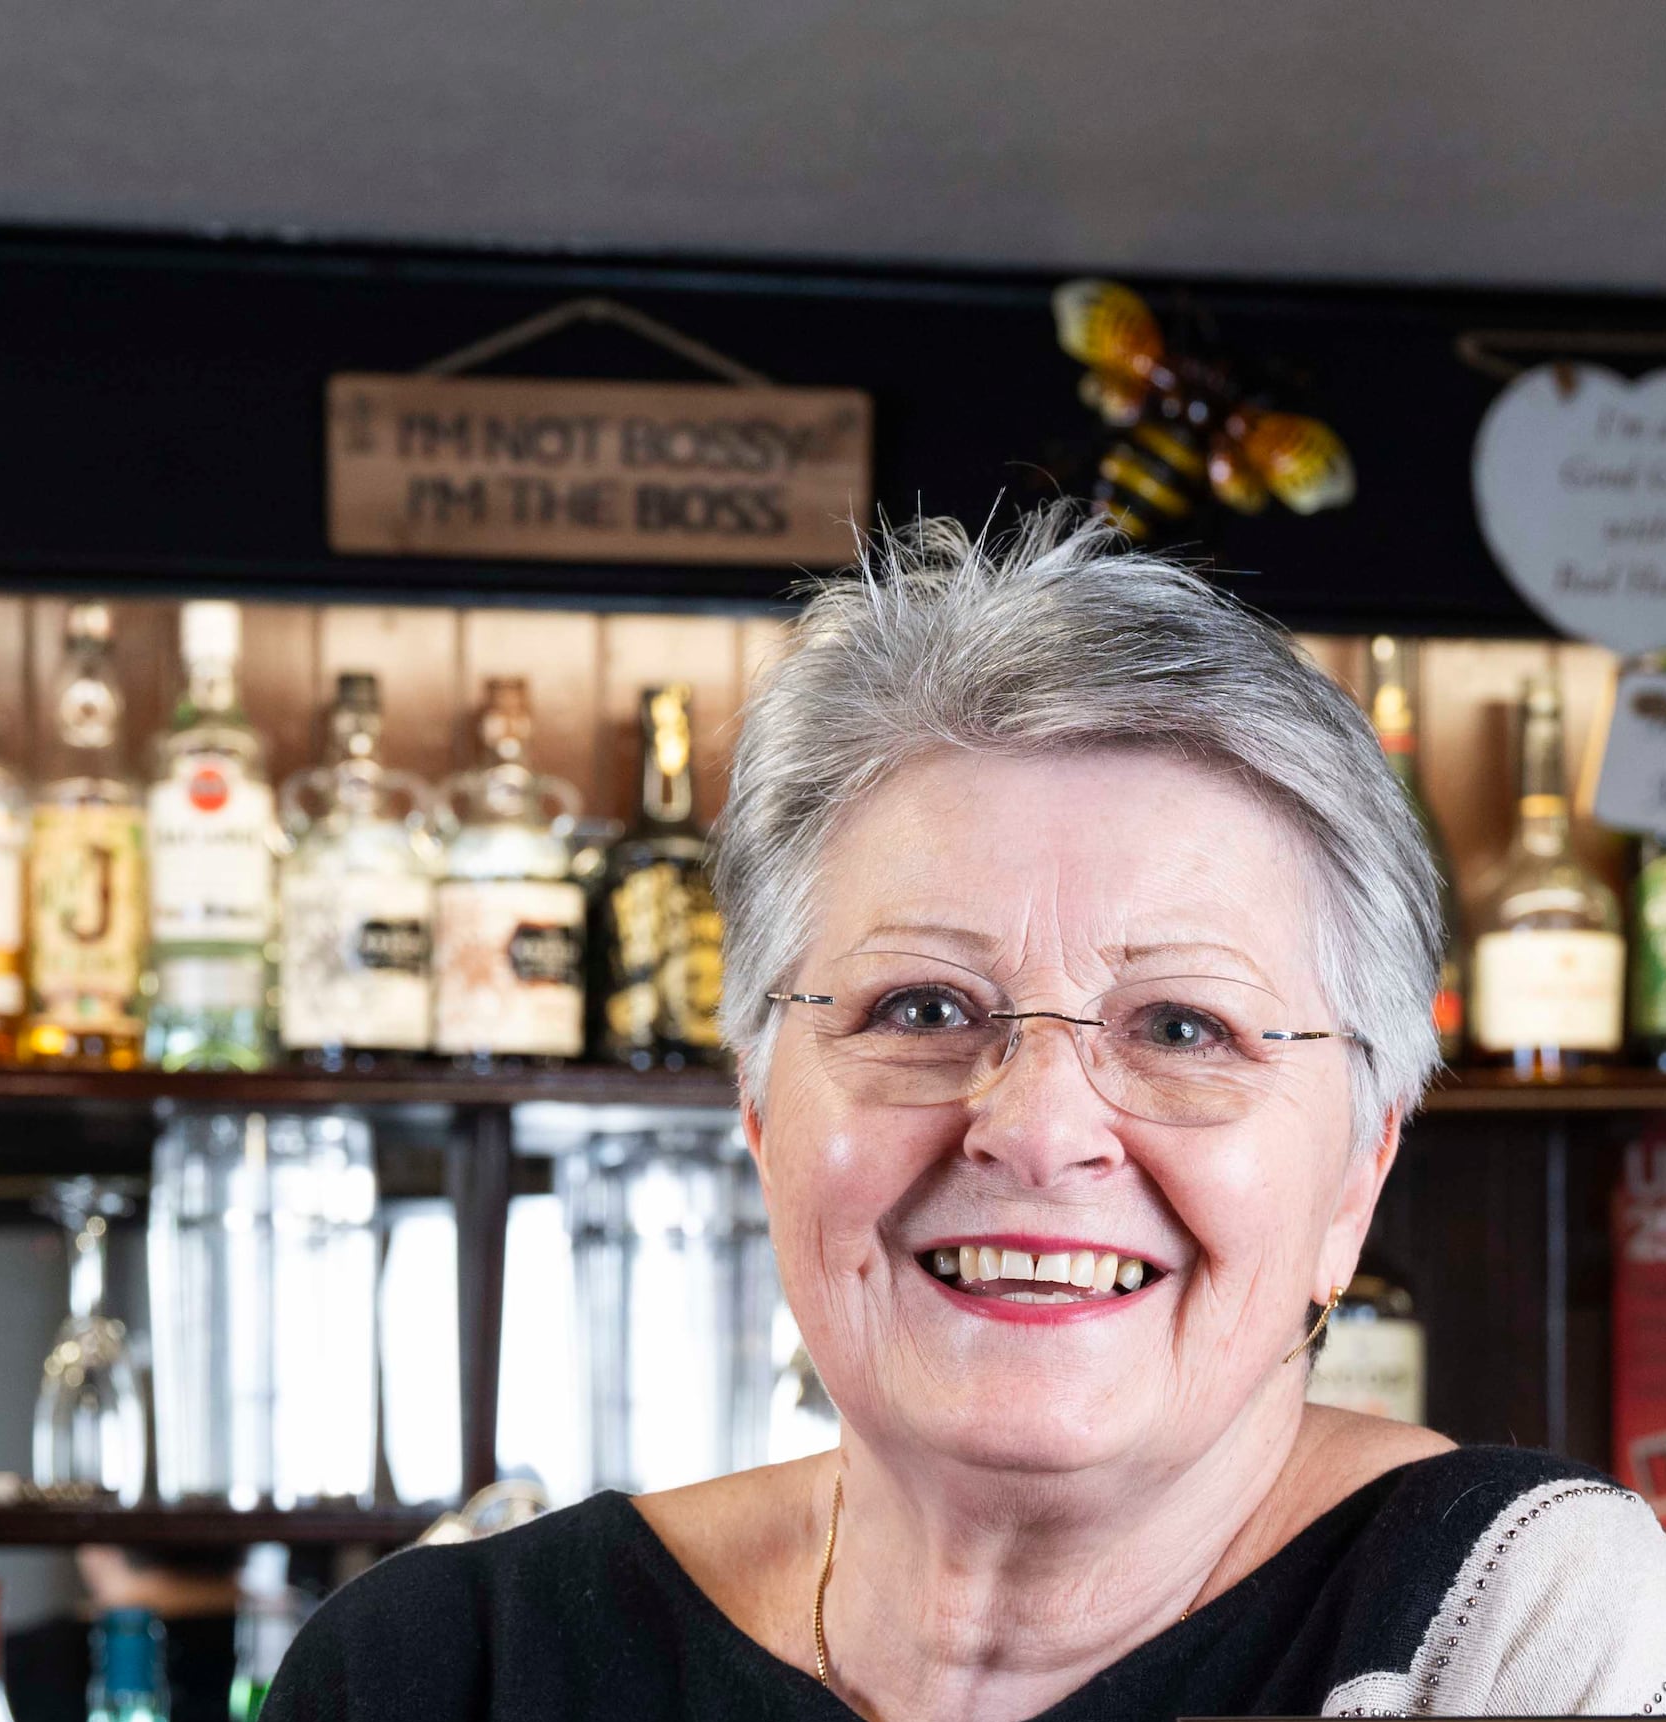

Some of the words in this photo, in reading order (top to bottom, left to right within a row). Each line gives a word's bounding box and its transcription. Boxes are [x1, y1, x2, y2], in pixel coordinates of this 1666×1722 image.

[397, 410, 475, 460] I'M
[484, 415, 608, 464] NOT
[407, 474, 488, 526] I'M
[505, 476, 621, 530] THE
[634, 480, 789, 537] BOSS
